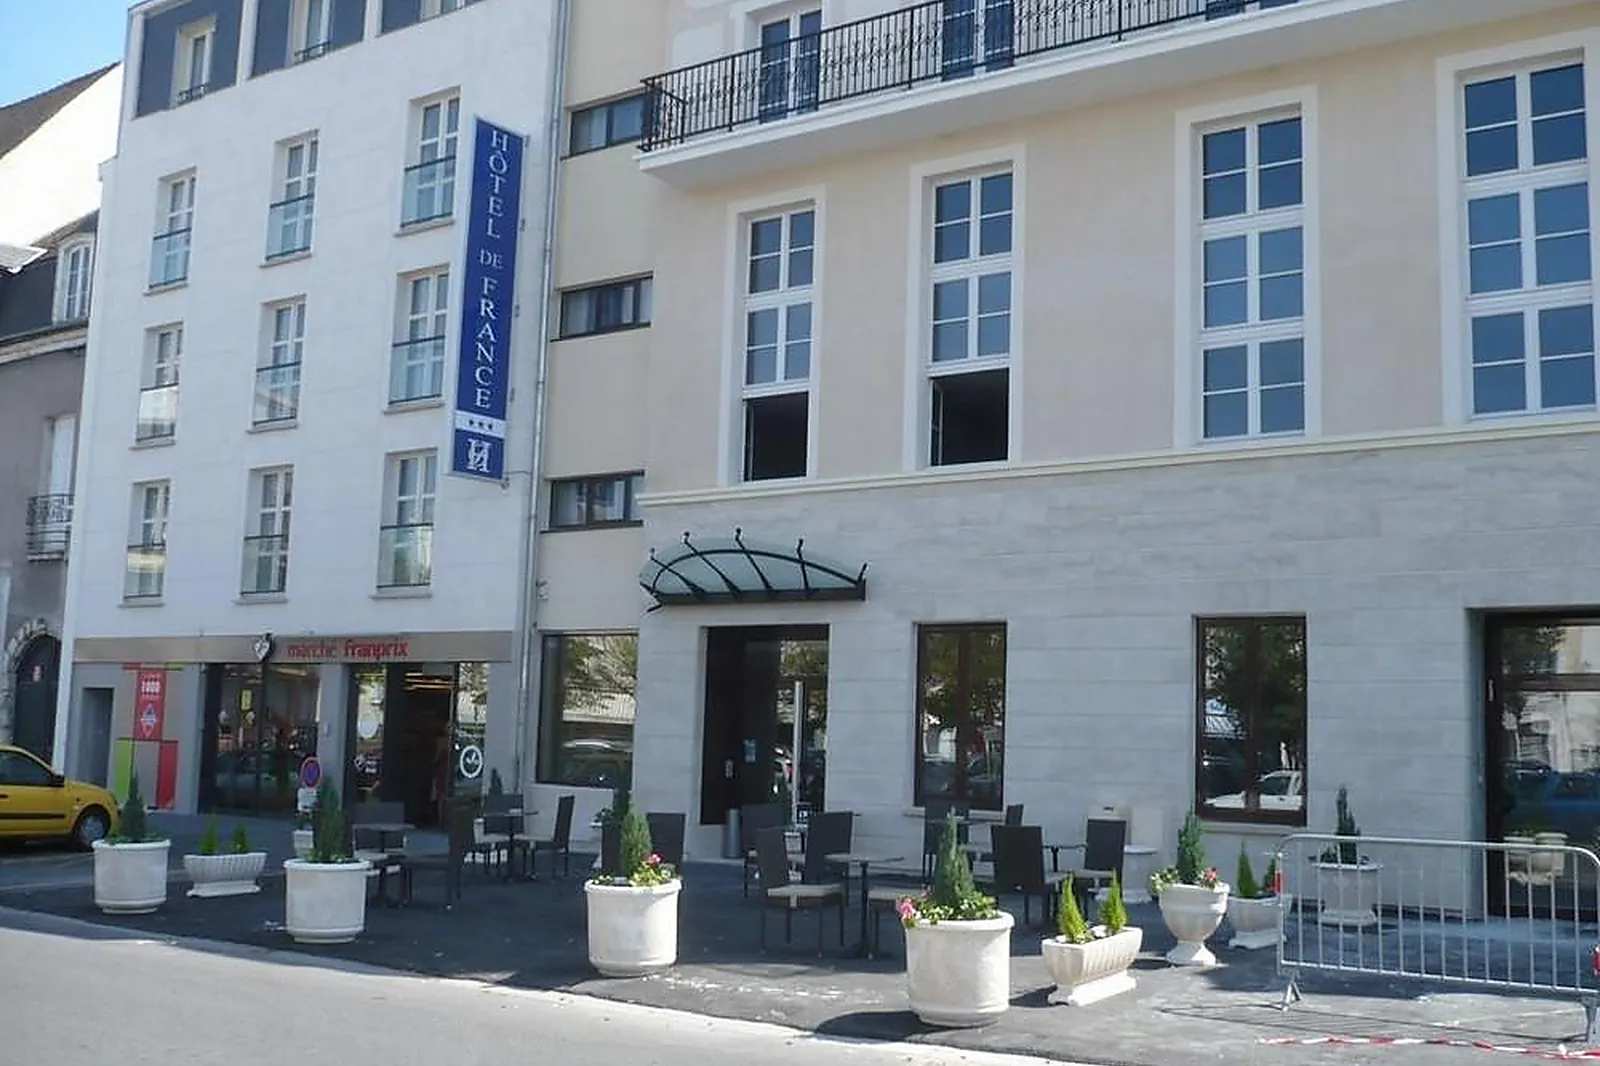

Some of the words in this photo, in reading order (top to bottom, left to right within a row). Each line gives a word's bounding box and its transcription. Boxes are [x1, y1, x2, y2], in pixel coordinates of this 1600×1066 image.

[487, 129, 508, 239] HÔTEL
[479, 248, 503, 270] DE
[475, 275, 498, 409] FRANCE
[345, 637, 409, 660] franprix
